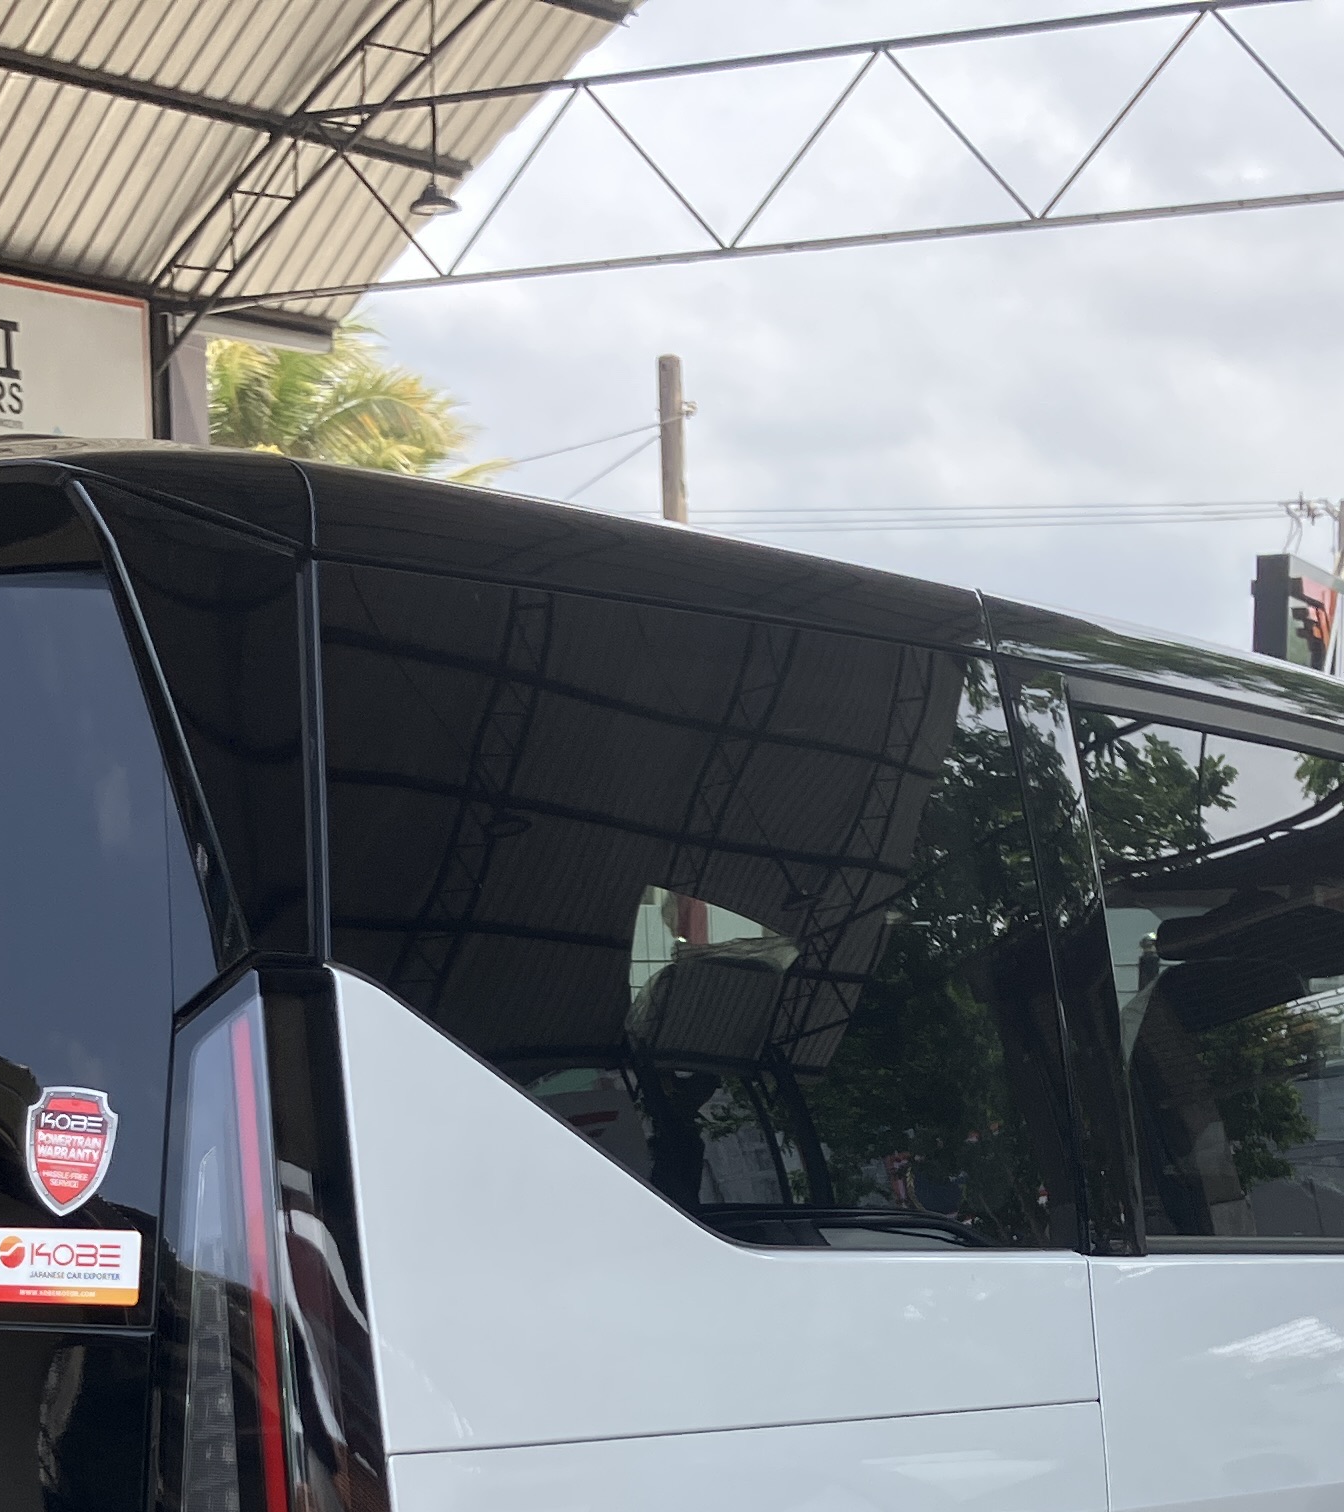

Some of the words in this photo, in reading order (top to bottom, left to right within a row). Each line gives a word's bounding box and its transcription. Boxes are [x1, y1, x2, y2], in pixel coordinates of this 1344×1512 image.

[40, 1112, 104, 1133] KOBE
[37, 1130, 102, 1149] POWERTRAIN
[37, 1145, 100, 1162] WARRANTY
[30, 1243, 121, 1268] KOBE
[29, 1271, 65, 1280] JAPANESE
[67, 1272, 82, 1280] CAR
[83, 1273, 120, 1281] EXPORTER
